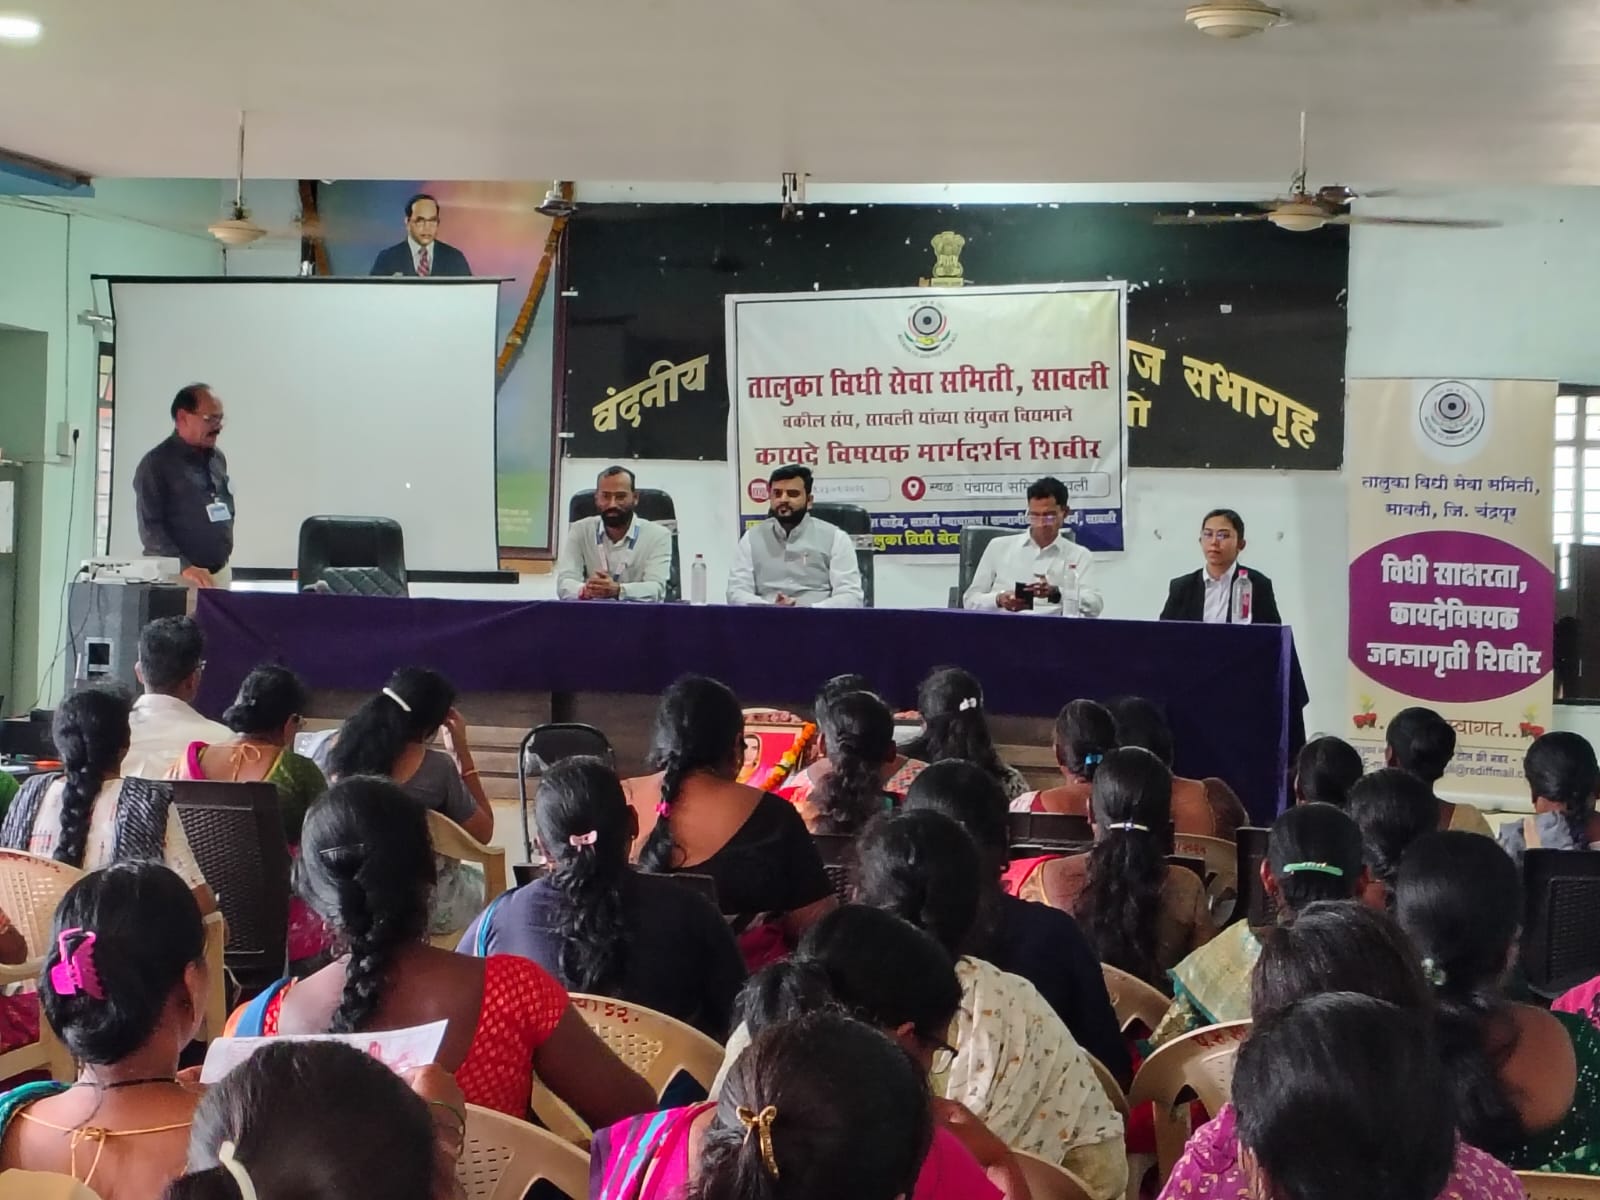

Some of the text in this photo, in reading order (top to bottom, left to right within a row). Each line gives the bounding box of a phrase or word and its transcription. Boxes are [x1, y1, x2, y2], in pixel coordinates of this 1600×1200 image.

[747, 361, 1110, 405] तालुका विधी सेवा समिती, सावली
[592, 354, 709, 432] वंदनीय
[1182, 355, 1318, 449] सभागृह
[783, 412, 825, 428] वकील
[866, 409, 913, 426] सावली
[919, 408, 959, 425] यांच्या
[964, 407, 1009, 429] संयुक्त
[754, 435, 1102, 466] कायदे विषयक मार्गदर्शन शिबीर
[964, 479, 1003, 493] पंचायत
[1362, 475, 1409, 493] तालुका
[1415, 473, 1448, 491] विधी
[1444, 501, 1468, 517] जि.
[1475, 502, 1517, 524] चंद्रपूर
[873, 534, 903, 551] लुका
[905, 529, 934, 545] विधी
[1381, 553, 1528, 593] विधी साक्षरता,
[1389, 597, 1520, 630] कायदेविषयक
[1366, 639, 1542, 678] जनजागृती शिबीर
